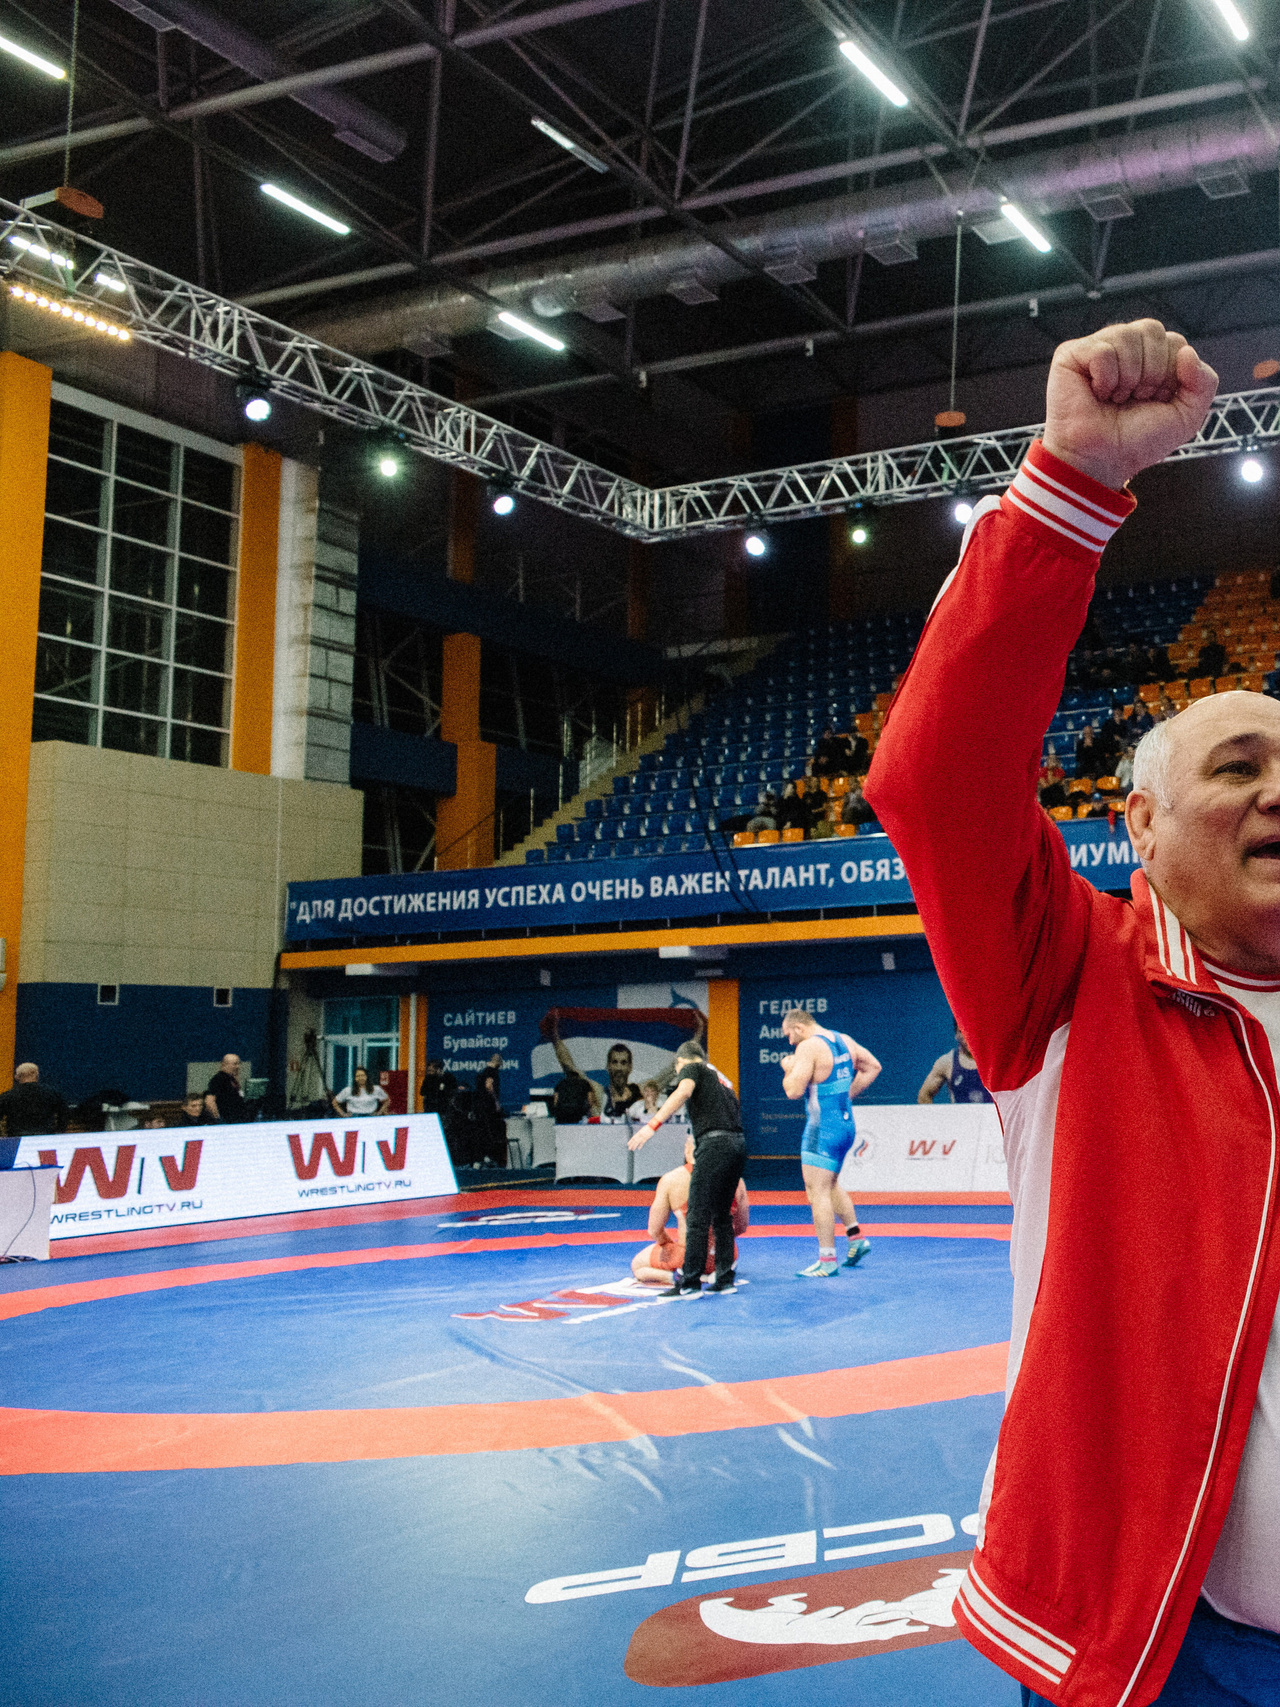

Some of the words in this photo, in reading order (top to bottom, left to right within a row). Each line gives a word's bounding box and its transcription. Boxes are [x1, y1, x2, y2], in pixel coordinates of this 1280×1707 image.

[337, 887, 480, 922] ДОСТИЖЕНИЯ
[485, 882, 566, 909] УСПЕХА
[571, 878, 644, 903] ОЧЕНЬ
[650, 870, 730, 897] ВАЖЕН
[737, 862, 835, 892] ТАЛАНТ,
[759, 998, 828, 1017] ГЕДУЕВ
[443, 1009, 516, 1027] САЙТИЕВ
[443, 1034, 509, 1053] Бувайсар
[297, 1179, 412, 1199] WRESTLINGTV.RU
